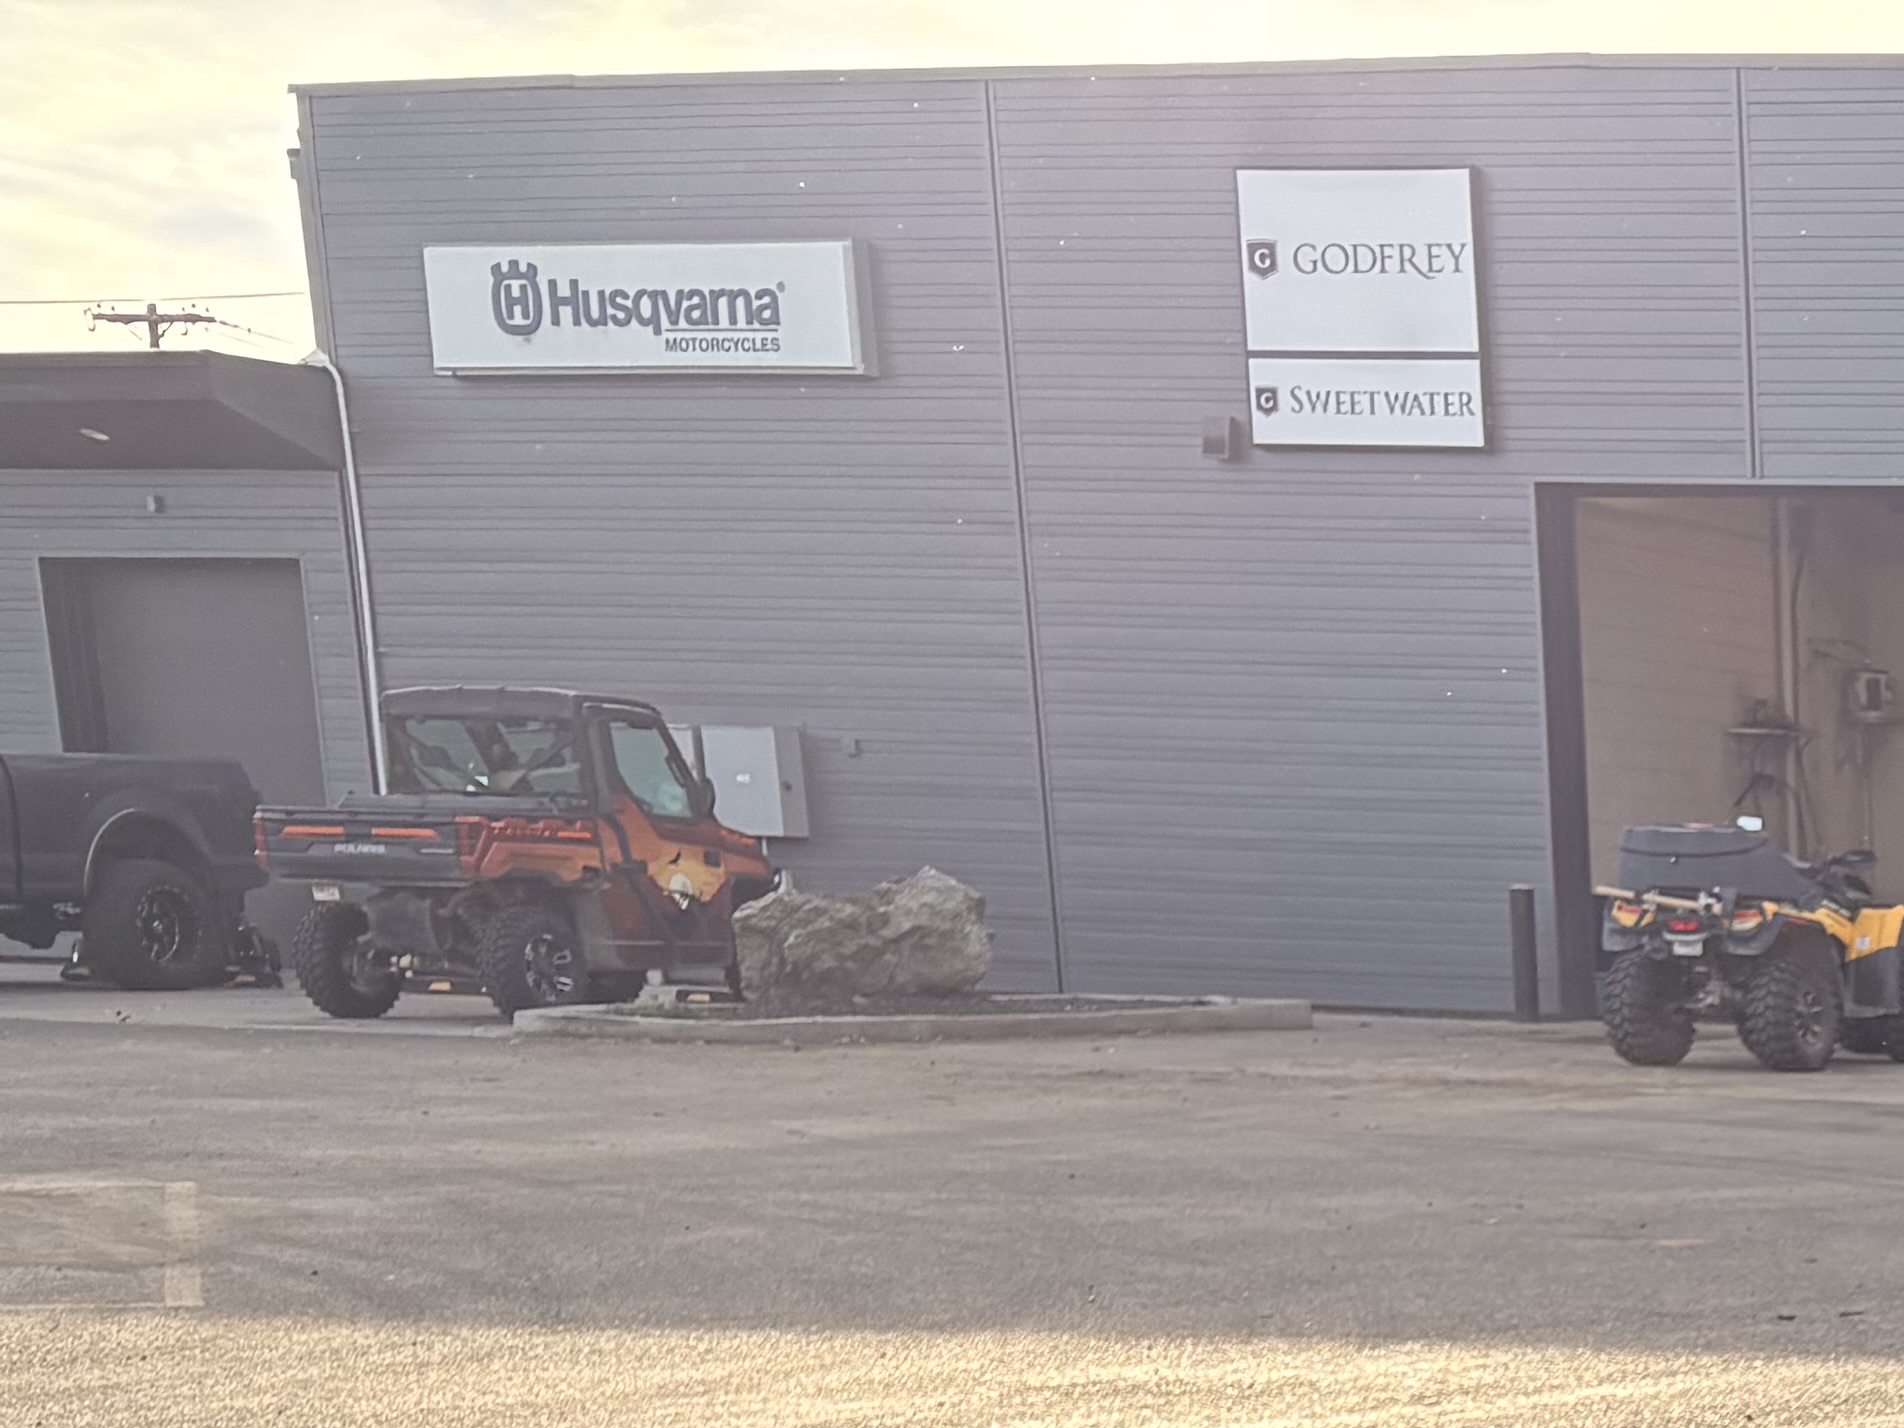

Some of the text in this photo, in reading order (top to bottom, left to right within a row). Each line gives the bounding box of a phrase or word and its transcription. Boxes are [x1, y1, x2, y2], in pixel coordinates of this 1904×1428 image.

[1292, 242, 1468, 280] GODFREY
[548, 277, 781, 336] Husqvarna
[665, 336, 781, 354] MOTORCYCLES
[1289, 384, 1476, 417] SWEETWATER
